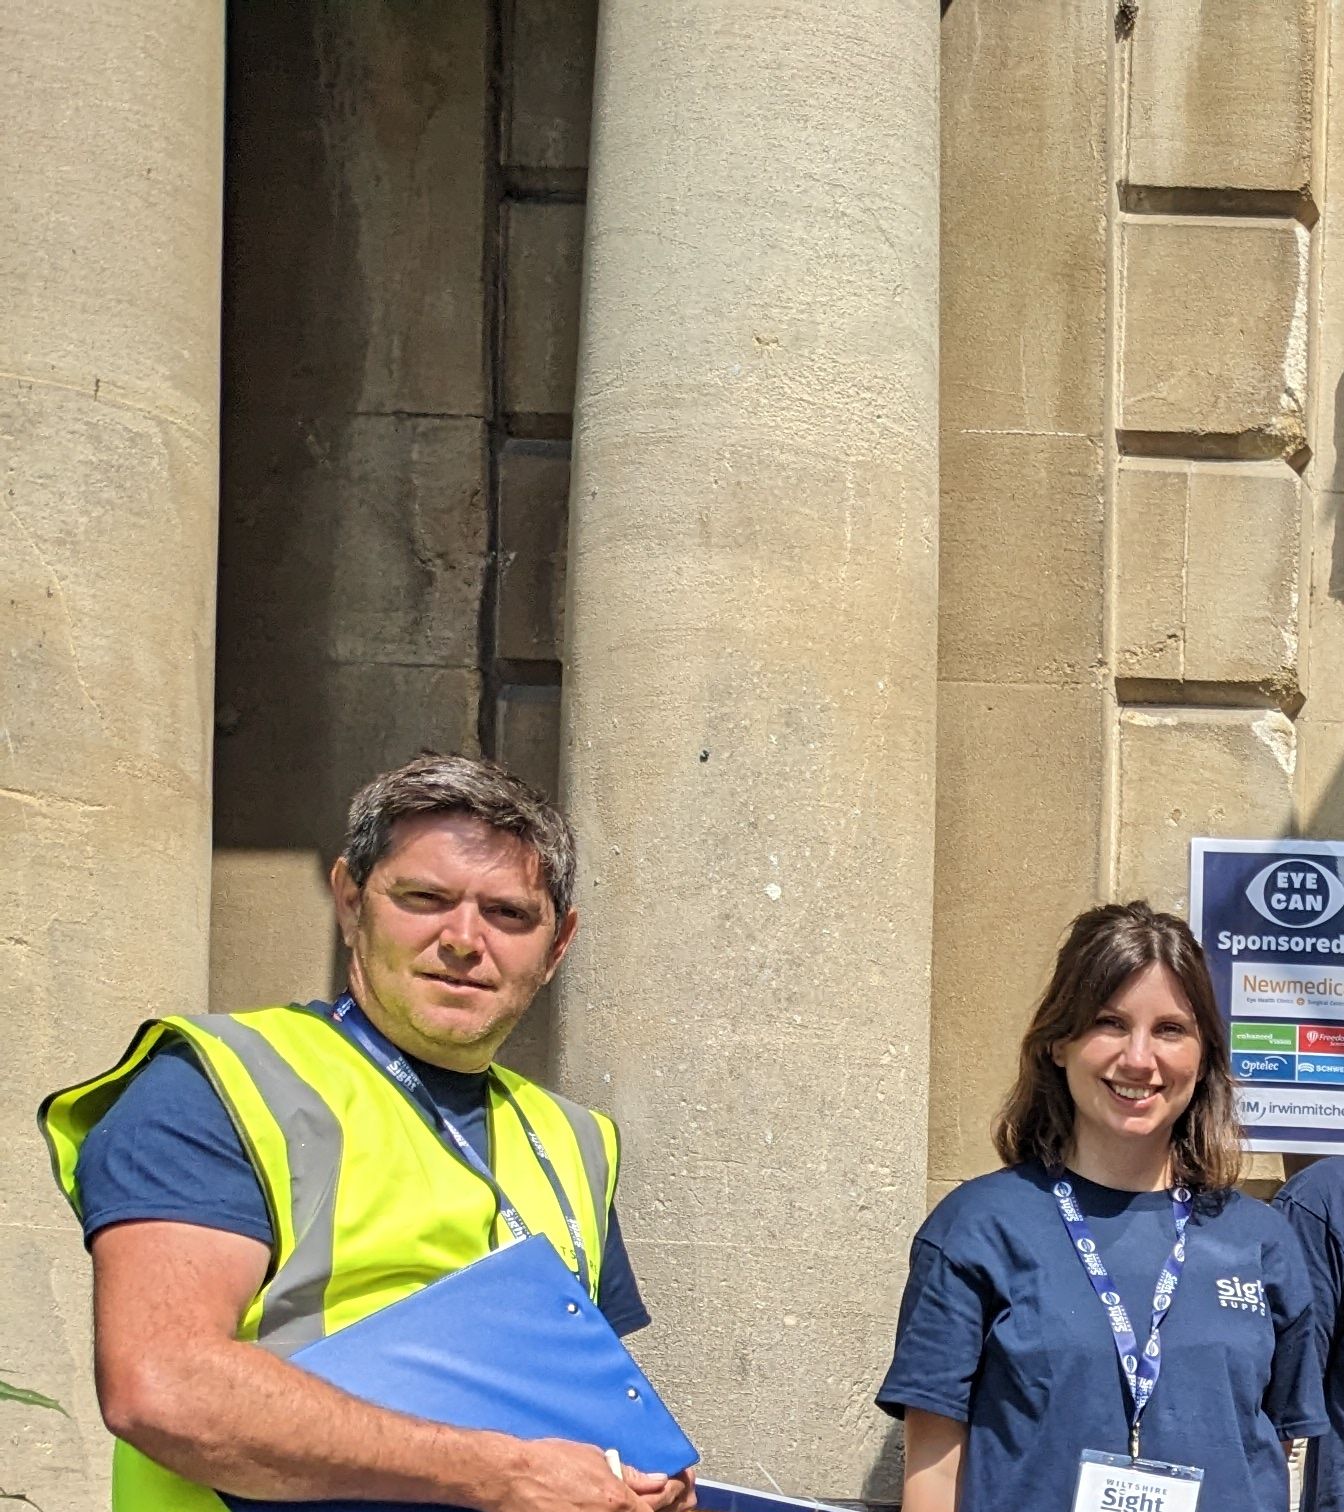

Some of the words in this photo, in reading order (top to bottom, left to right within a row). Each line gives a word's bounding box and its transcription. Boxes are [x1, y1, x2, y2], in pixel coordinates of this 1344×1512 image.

[1277, 872, 1318, 889] EYE
[1271, 893, 1323, 911] CAN
[1217, 931, 1344, 955] Sponsored
[386, 1060, 418, 1092] Sight
[1241, 1059, 1279, 1074] Optelec
[501, 1208, 527, 1240] Sigh
[1216, 1276, 1264, 1304] Sig
[1106, 1479, 1167, 1495] WILTSHIRE
